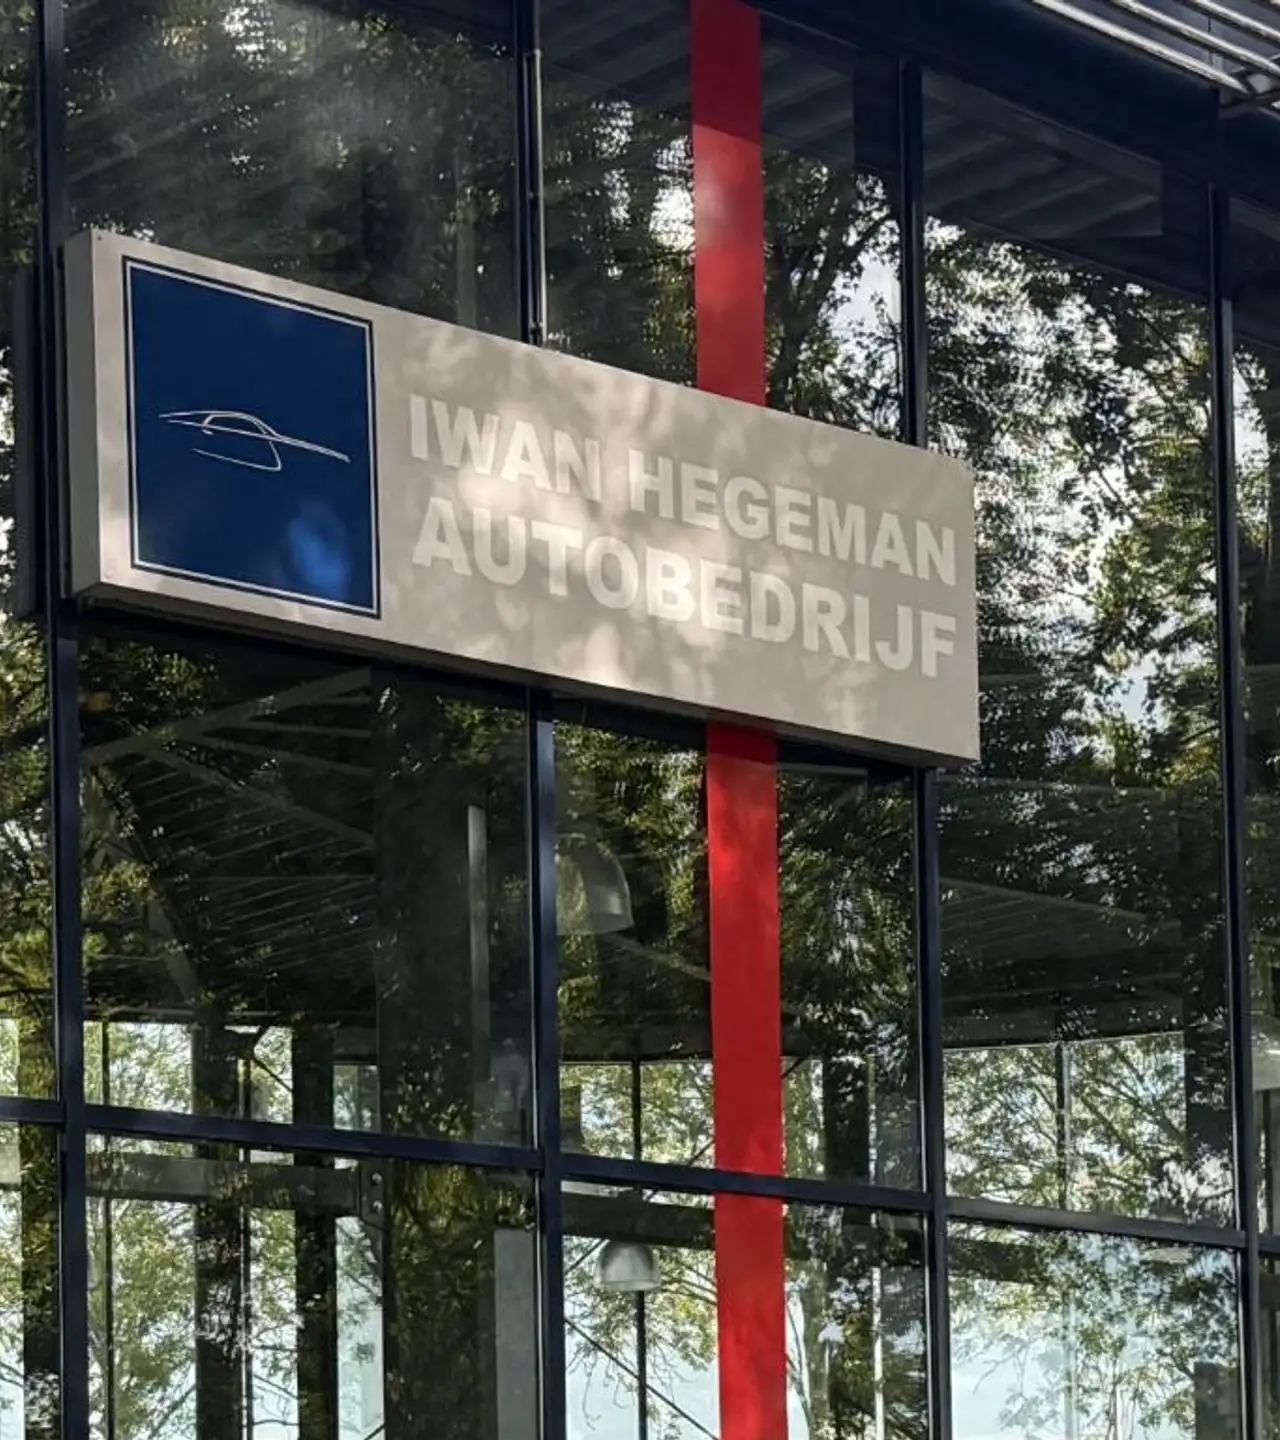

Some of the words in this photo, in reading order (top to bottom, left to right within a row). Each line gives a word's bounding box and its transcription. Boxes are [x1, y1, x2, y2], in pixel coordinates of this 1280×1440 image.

[409, 397, 601, 503] IWAN
[629, 450, 956, 587] HEGEMAN
[412, 497, 957, 678] AUTOBEDRIJF
